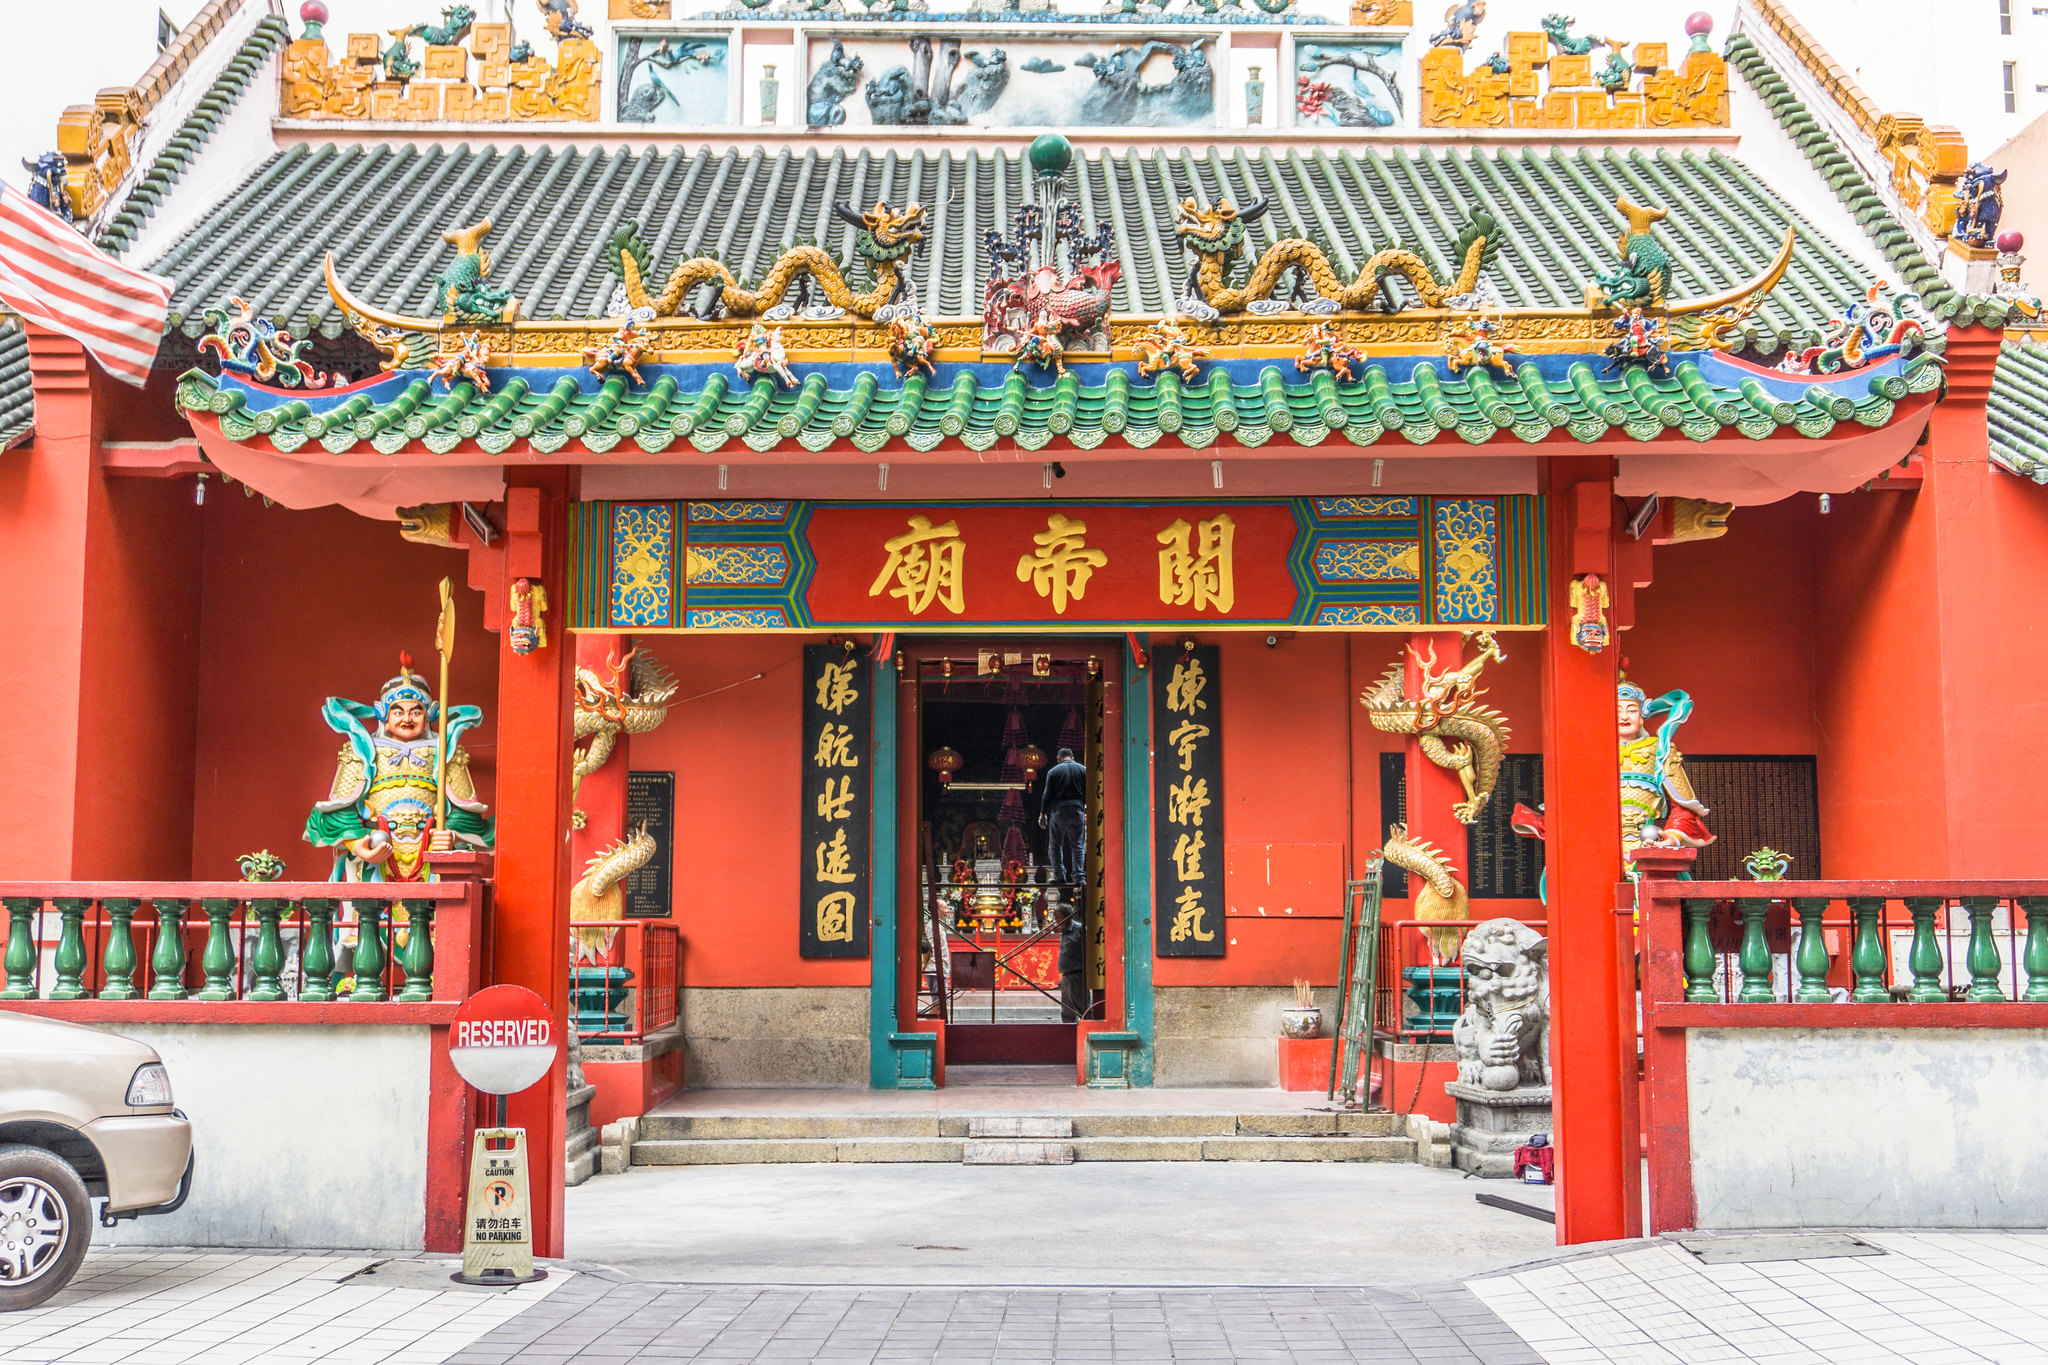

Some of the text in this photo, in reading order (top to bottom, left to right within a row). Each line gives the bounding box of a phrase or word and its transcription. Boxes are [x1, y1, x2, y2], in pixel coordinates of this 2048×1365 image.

[458, 1019, 550, 1047] RESERVED
[490, 1159, 510, 1168] 警告
[485, 1168, 514, 1177] CAUTION
[475, 1217, 522, 1230] 请勿泊车
[476, 1231, 522, 1242] NO PARKING
